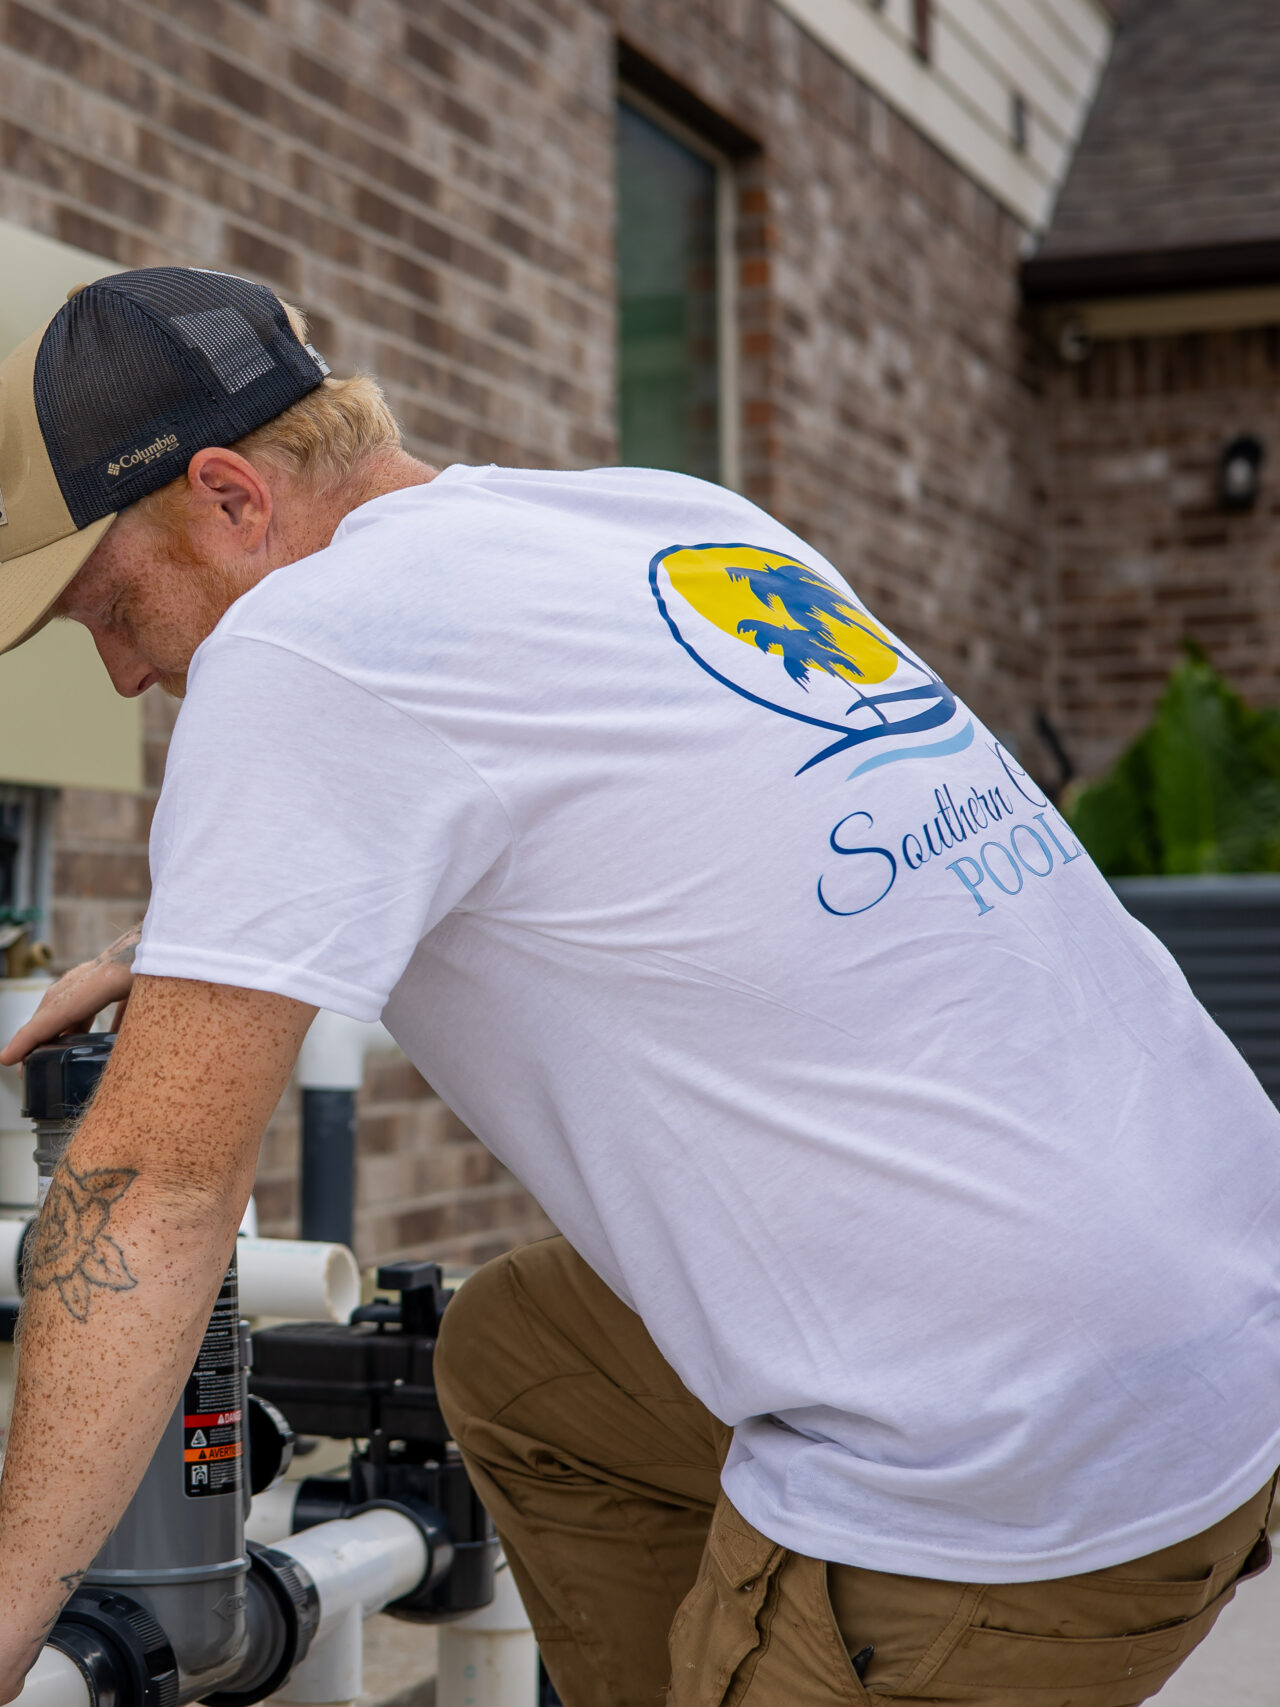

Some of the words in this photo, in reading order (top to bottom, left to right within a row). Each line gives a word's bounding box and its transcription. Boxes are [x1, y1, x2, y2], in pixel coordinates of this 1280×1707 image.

[119, 433, 178, 468] Columbia
[817, 783, 1014, 916] Southern
[944, 812, 1087, 917] POOL
